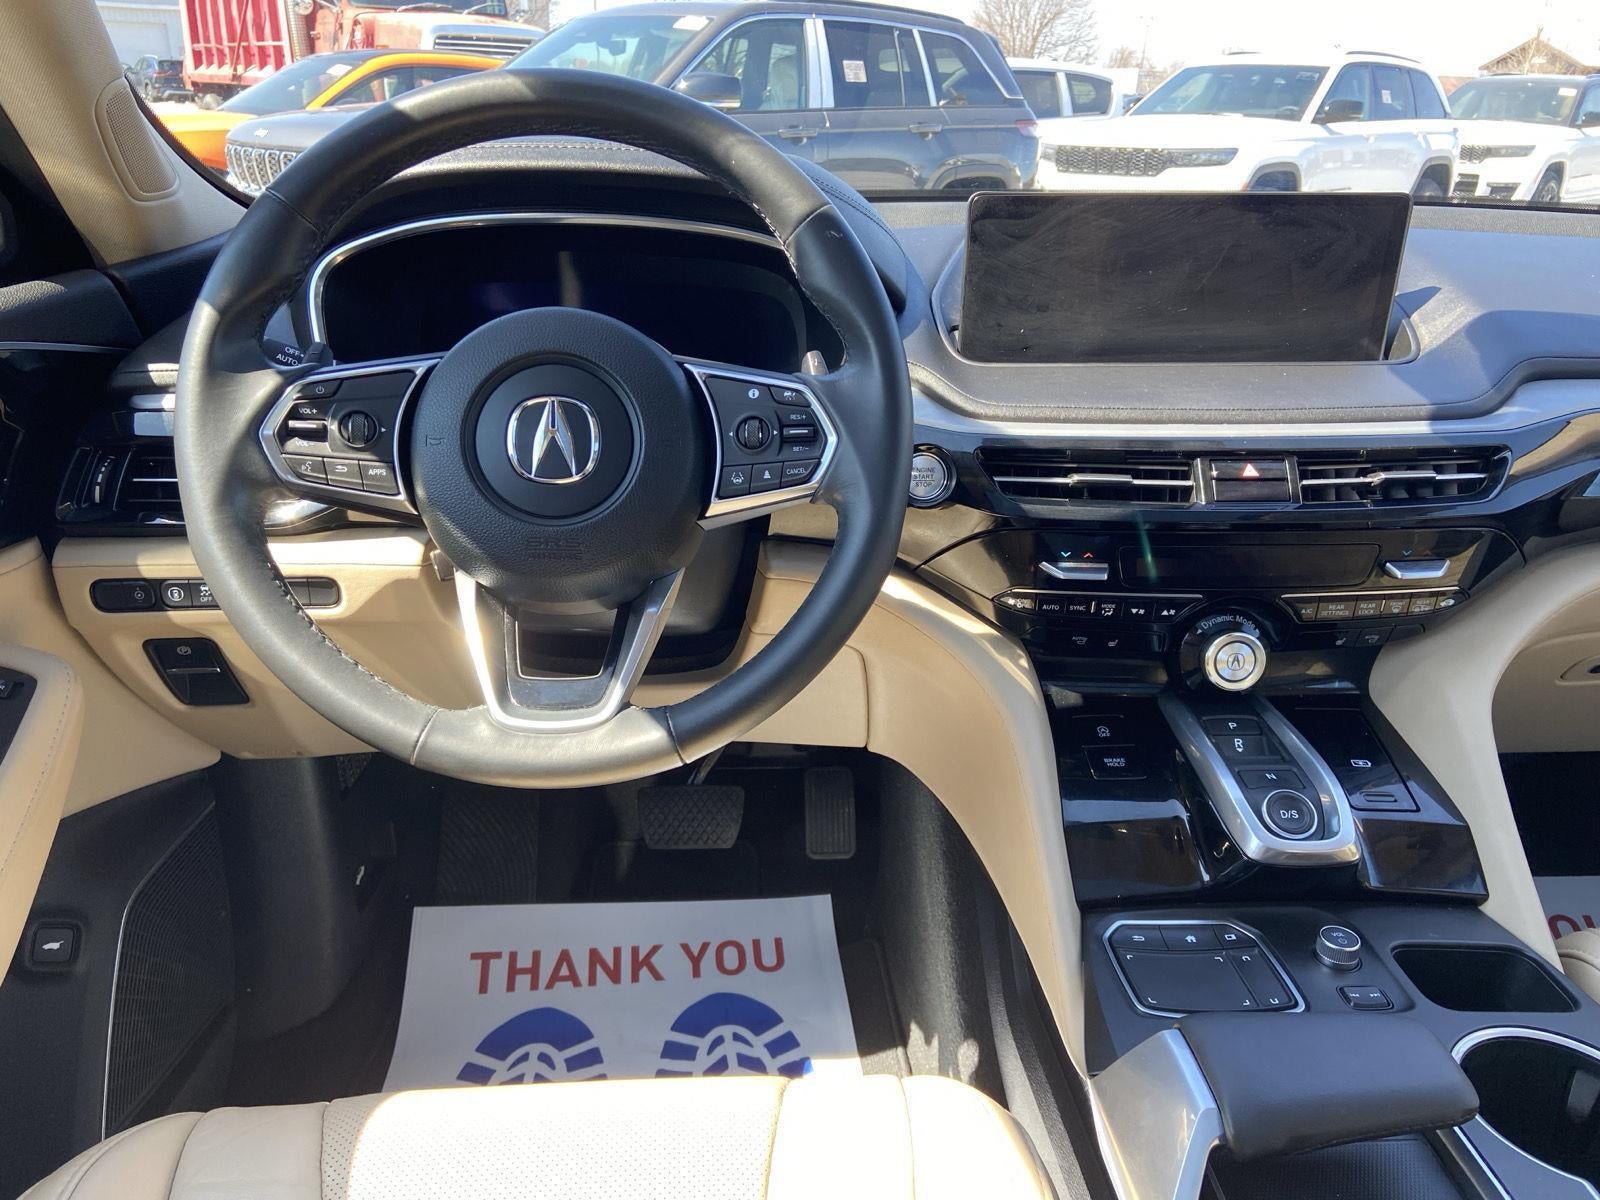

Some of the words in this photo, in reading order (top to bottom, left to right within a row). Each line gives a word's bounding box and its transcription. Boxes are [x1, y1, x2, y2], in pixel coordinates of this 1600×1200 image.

[284, 346, 301, 357] OFF
[275, 353, 299, 367] AUTO
[368, 468, 387, 476] APPS
[786, 468, 807, 476] CANCEL
[1201, 615, 1234, 629] Dynamic
[1235, 615, 1256, 629] Mode
[1229, 721, 1237, 730] P
[1234, 738, 1243, 748] R
[1280, 809, 1299, 819] D/S
[469, 944, 665, 995] THANK
[680, 936, 786, 979] YOU
